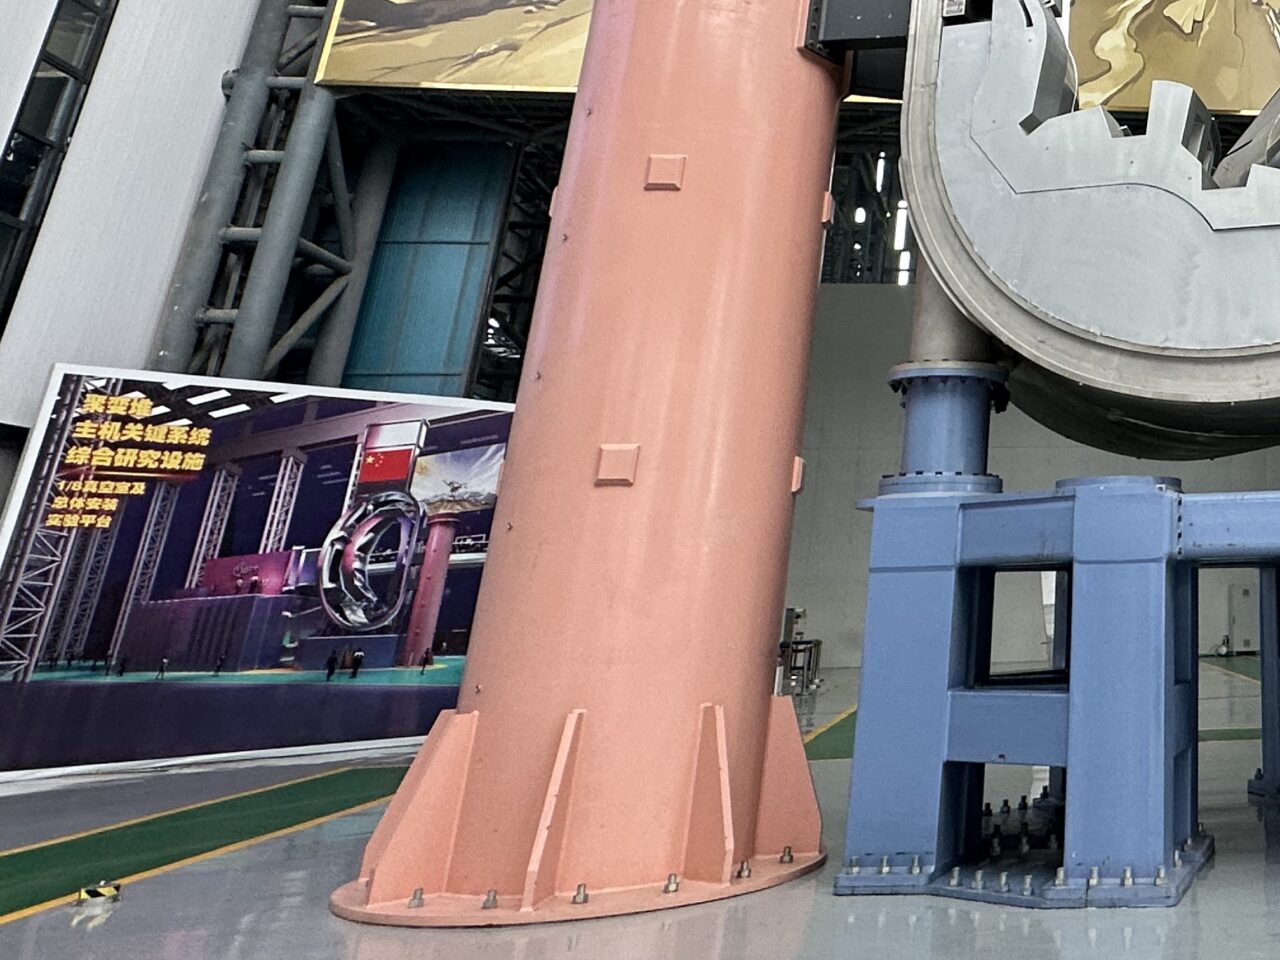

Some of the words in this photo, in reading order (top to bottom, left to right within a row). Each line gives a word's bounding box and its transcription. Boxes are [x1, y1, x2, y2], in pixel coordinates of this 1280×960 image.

[83, 394, 153, 416] 聚变堆
[72, 420, 211, 445] 主机关键系统
[65, 446, 206, 470] 综合研究设施
[51, 496, 119, 511] 总体安装
[45, 513, 112, 528] 实验平台
